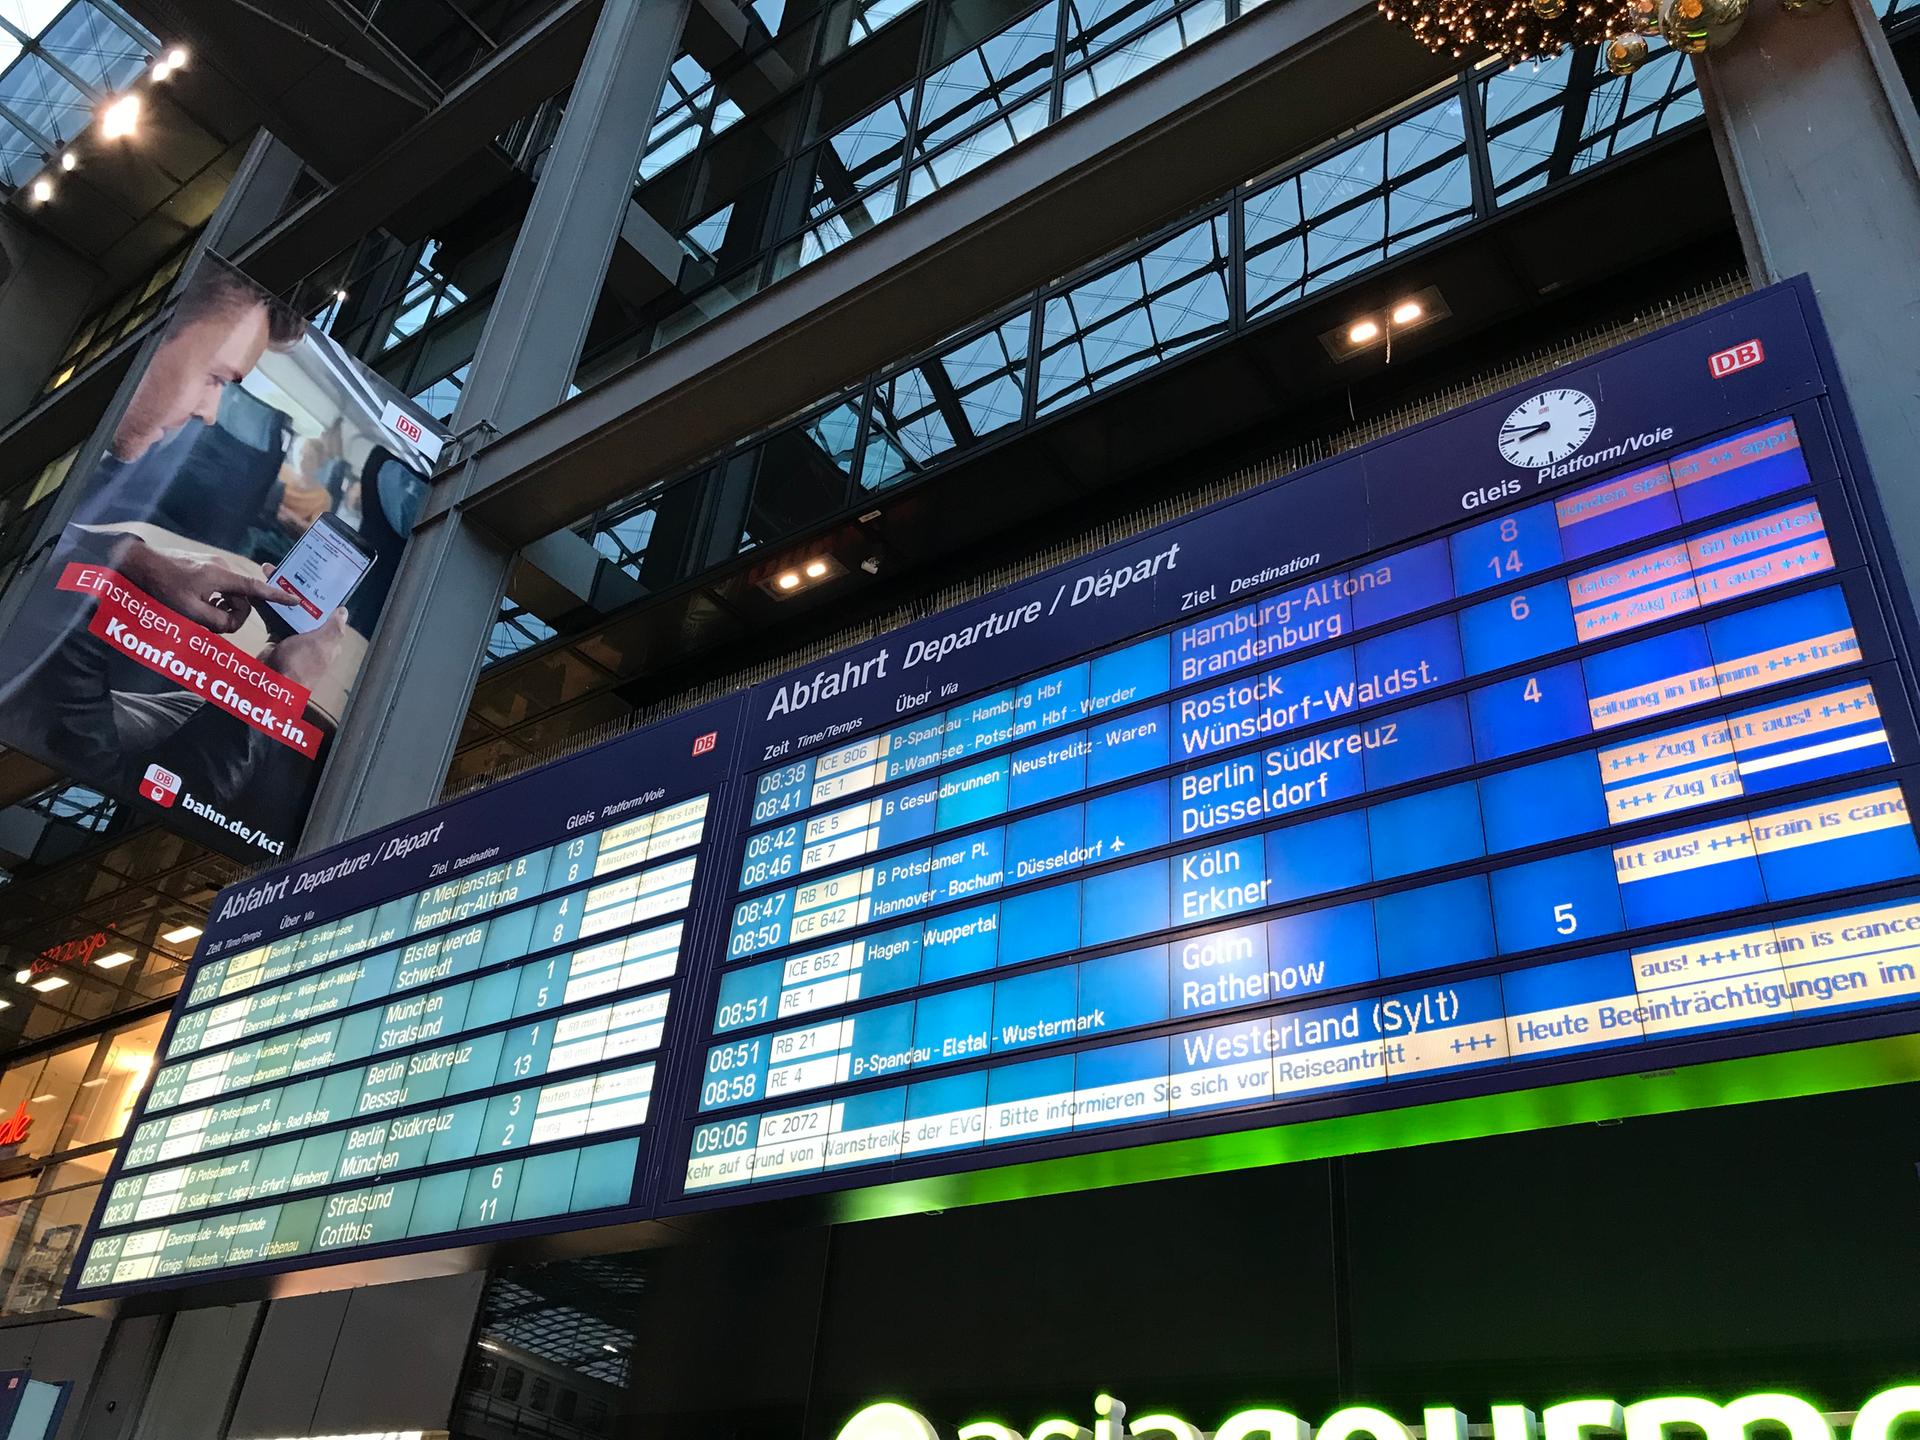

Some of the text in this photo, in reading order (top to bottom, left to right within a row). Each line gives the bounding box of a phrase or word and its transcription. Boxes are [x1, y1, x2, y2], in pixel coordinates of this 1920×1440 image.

[1711, 341, 1761, 376] DB
[397, 416, 421, 441] DB
[1461, 478, 1522, 510] Gleis
[1537, 426, 1674, 485] Platform/Voie
[1501, 519, 1518, 542] 8
[1488, 551, 1522, 579] 14
[1181, 553, 1320, 611] Ziel Destination
[1182, 566, 1392, 651] Hamburg-Altona
[1511, 596, 1529, 620] 6
[76, 569, 295, 706] Einsteigen, einchecken:
[766, 542, 1182, 720] Abfahrt Departure Départ
[1182, 613, 1342, 681] Brandenburg
[105, 617, 307, 747] Komfort Check-in.
[895, 682, 958, 713] Über Via
[1523, 678, 1541, 703] 4
[1181, 675, 1284, 724] Rostock
[1182, 660, 1438, 753] Wünsdorf-Waldst.
[890, 684, 1137, 777] B-Wannsee Potsdam Hbf Werder
[893, 681, 1062, 750] B-Spandau Hamburg Hbf
[694, 733, 716, 754] DB
[763, 716, 863, 761] Zeit Time/Temps
[1655, 731, 1696, 760] Zug
[819, 746, 867, 772] ICE 806
[900, 722, 1158, 811] Gesundbrunnen Neustrelitz Waren
[1182, 722, 1398, 801] Berlin Südkreuz
[154, 769, 173, 787] DB
[760, 764, 806, 794] 08:38
[566, 787, 665, 831] Gleis Platform/Voie
[755, 790, 801, 821] 08:41
[1182, 772, 1329, 834] Düsseldorf
[181, 793, 285, 856] bahn.de/kci
[1653, 811, 1842, 865] aus! is
[567, 840, 583, 860] 13
[748, 827, 796, 858] 08:42
[216, 822, 444, 923] Abfahrt Departure Départ
[428, 846, 500, 879] Ziel Destination
[568, 864, 578, 882] 8
[743, 854, 792, 885] 08:46
[891, 842, 989, 884] Potsdamer Pl.
[1182, 850, 1240, 883] Köln
[434, 864, 511, 903] Medienstadt
[800, 882, 838, 905] RB 10
[873, 840, 1103, 917] Hannover Bochum Düsseldorf
[413, 886, 518, 933] Hamburg-Altona
[559, 898, 568, 917] 4
[736, 893, 786, 926] 08:47
[1182, 879, 1272, 919] Erkner
[279, 914, 302, 931] Über
[553, 923, 564, 942] 8
[795, 908, 846, 935] ICE 642
[1554, 903, 1577, 935] 5
[206, 930, 262, 956] Zeit Time/Temps
[403, 928, 482, 965] Elsterwerda
[732, 923, 781, 955] 08:50
[868, 914, 997, 961] Hagen Wuppertal
[1640, 928, 1834, 978] aus! is
[788, 952, 840, 977] ICE 652
[1182, 937, 1252, 970] Golm
[397, 957, 453, 989] Schwedt
[547, 960, 555, 979] 1
[188, 982, 217, 1004] 07:06
[537, 987, 549, 1007] 5
[1183, 961, 1325, 1010] Rathenow
[177, 1012, 206, 1034] 07:18
[385, 995, 443, 1024] München
[718, 996, 768, 1028] 08:51
[379, 1016, 444, 1049] Stralsund
[531, 1026, 540, 1046] 1
[776, 1031, 816, 1055] RB 21
[853, 1008, 1105, 1075] B-Spandau Elstal Wustermark
[1184, 990, 1459, 1066] Westerland (Sylt)
[168, 1033, 198, 1056] 07:33
[709, 1040, 759, 1073] 08:51
[156, 1065, 187, 1087] 07:37
[367, 1047, 473, 1086] Berlin Südkreuz
[514, 1054, 532, 1077] 13
[718, 961, 1916, 1176] auf Grund von Warnstreiks der EVG Bitte informieren Sie sich vor Reiseantritt Heute Beeinträchtigungen im
[148, 1087, 179, 1110] 07:42
[358, 1088, 409, 1113] Dessau
[509, 1095, 521, 1116] 3
[704, 1074, 756, 1106] 08:58
[135, 1120, 165, 1143] 07:47
[347, 1112, 454, 1151] Berlin Südkreuz
[502, 1124, 515, 1147] 2
[696, 1121, 748, 1153] 09:06
[763, 1112, 819, 1137] IC 2072
[126, 1143, 156, 1167] 08:15
[339, 1152, 400, 1179] München
[112, 1177, 142, 1200] 08:18
[492, 1167, 503, 1190] 6
[103, 1202, 134, 1225] 08:30
[327, 1187, 394, 1219] Stralsund
[480, 1197, 497, 1221] 11
[90, 1237, 121, 1260] 08:32
[319, 1222, 374, 1248] Cottbus
[81, 1262, 111, 1285] 08:35
